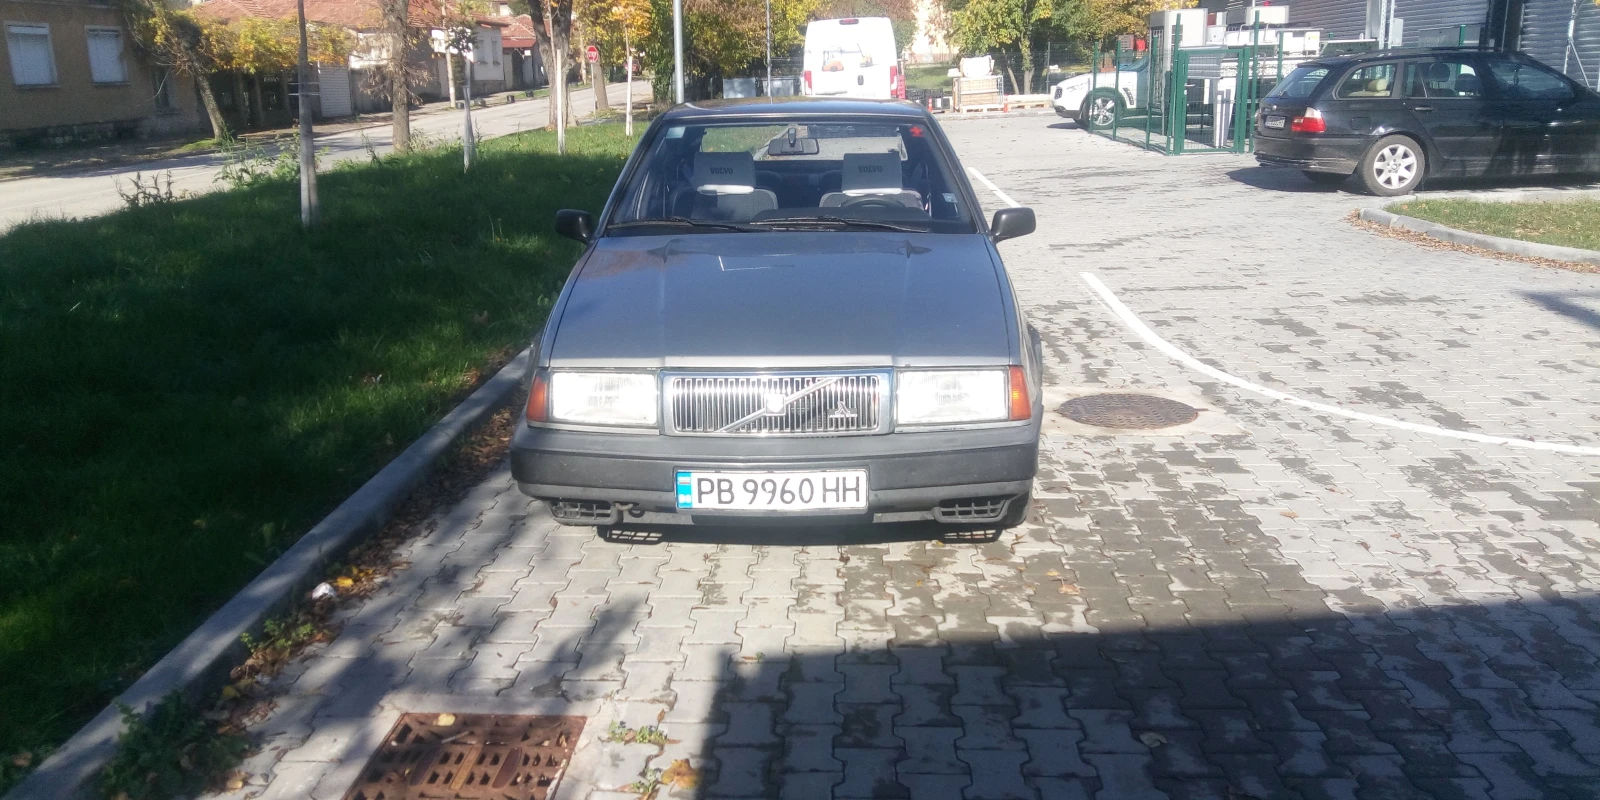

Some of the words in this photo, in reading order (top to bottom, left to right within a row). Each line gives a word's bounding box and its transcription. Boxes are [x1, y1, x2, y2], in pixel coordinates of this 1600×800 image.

[858, 165, 883, 173] VOLVO
[697, 477, 735, 505] PB
[742, 477, 814, 505] 9960
[822, 476, 860, 503] HH
